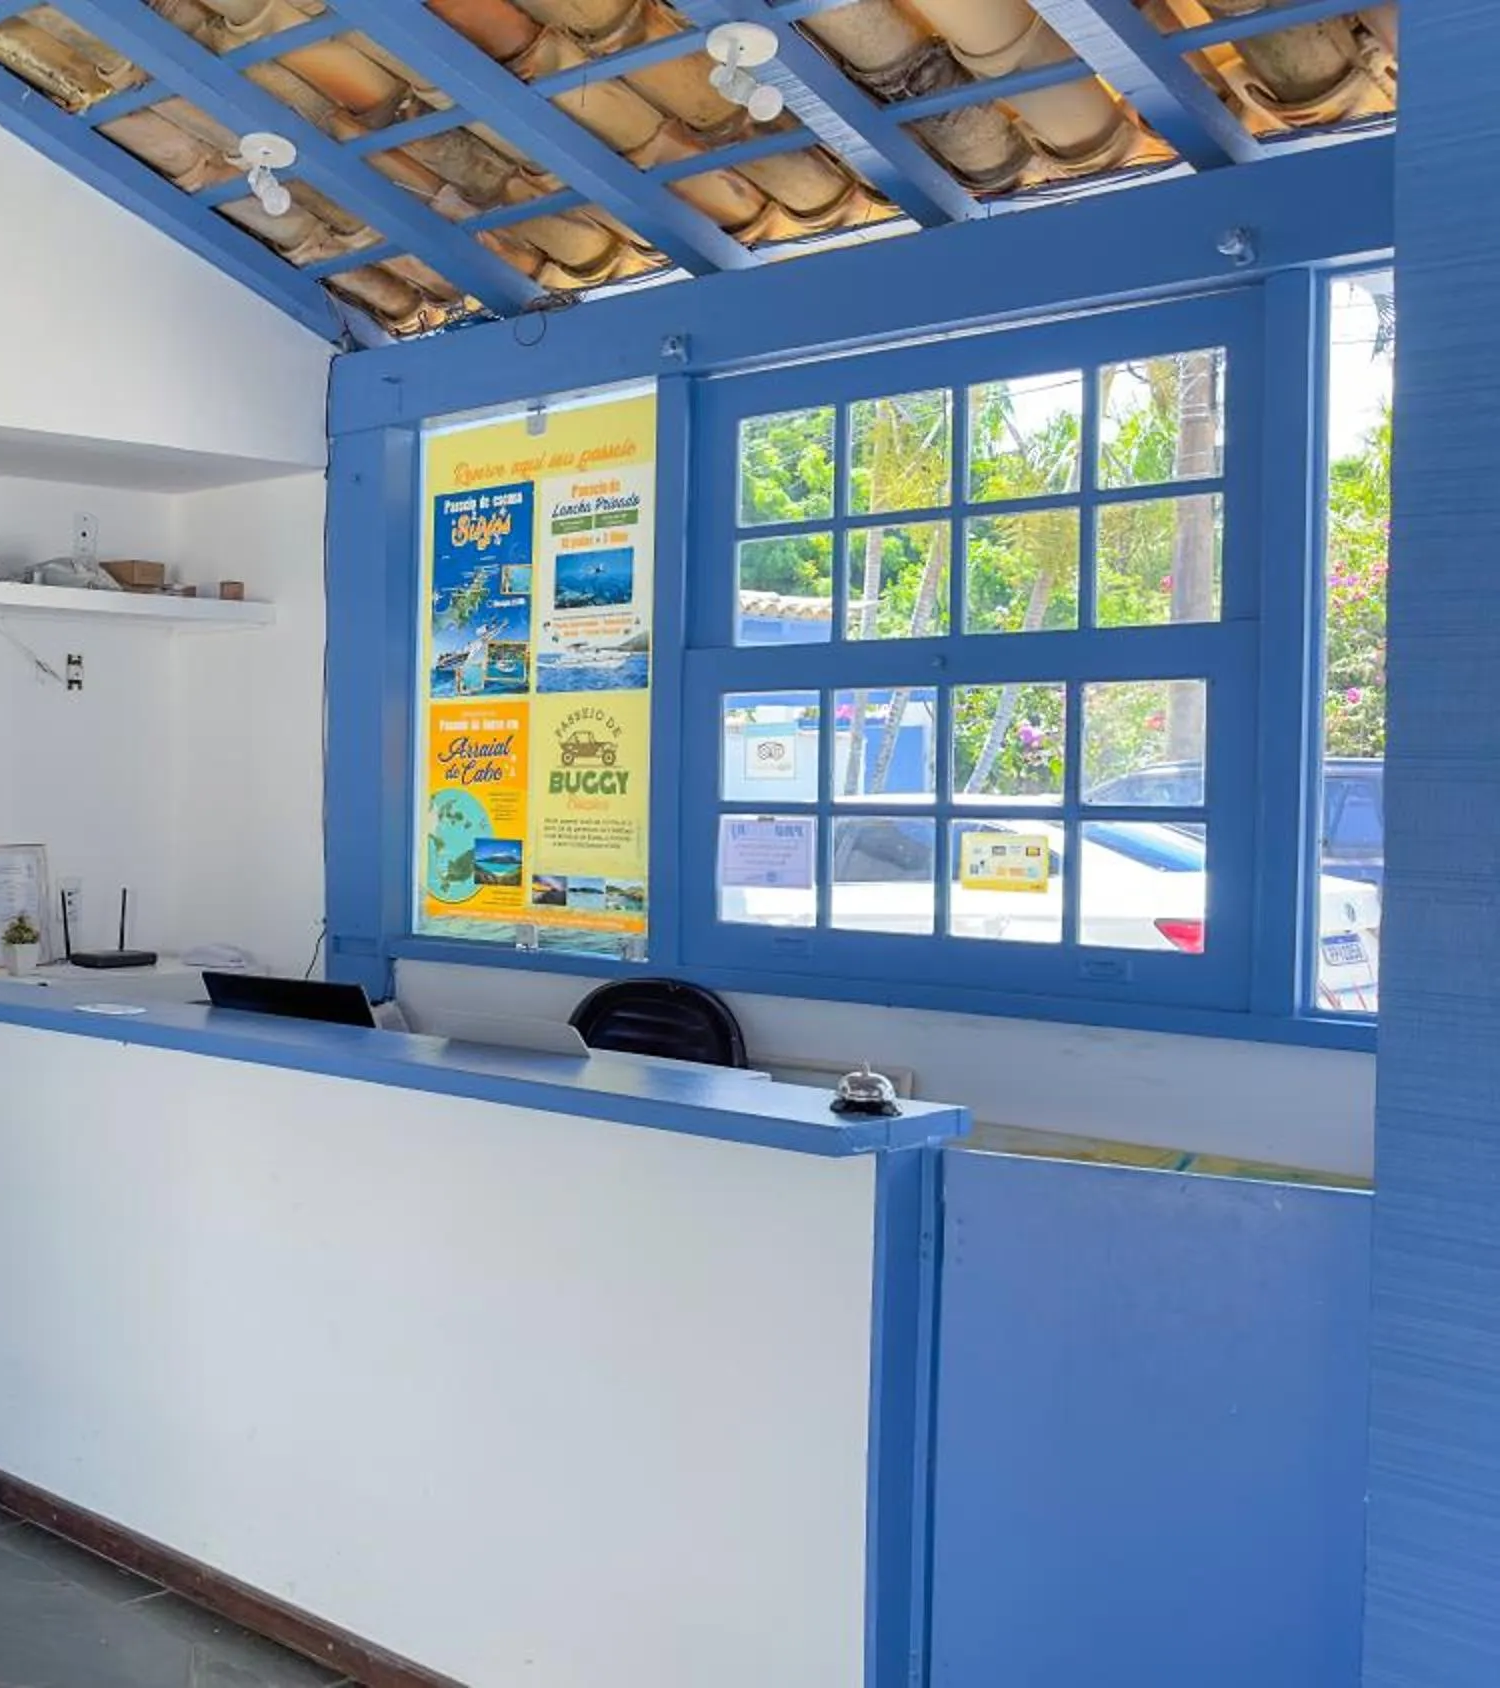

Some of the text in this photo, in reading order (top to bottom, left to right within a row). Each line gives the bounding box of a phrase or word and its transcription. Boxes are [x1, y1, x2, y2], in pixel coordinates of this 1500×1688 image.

[555, 707, 622, 738] PASSEIO DE
[437, 734, 514, 762] Arraial
[462, 759, 502, 785] Cabo
[548, 771, 629, 795] BUGGY
